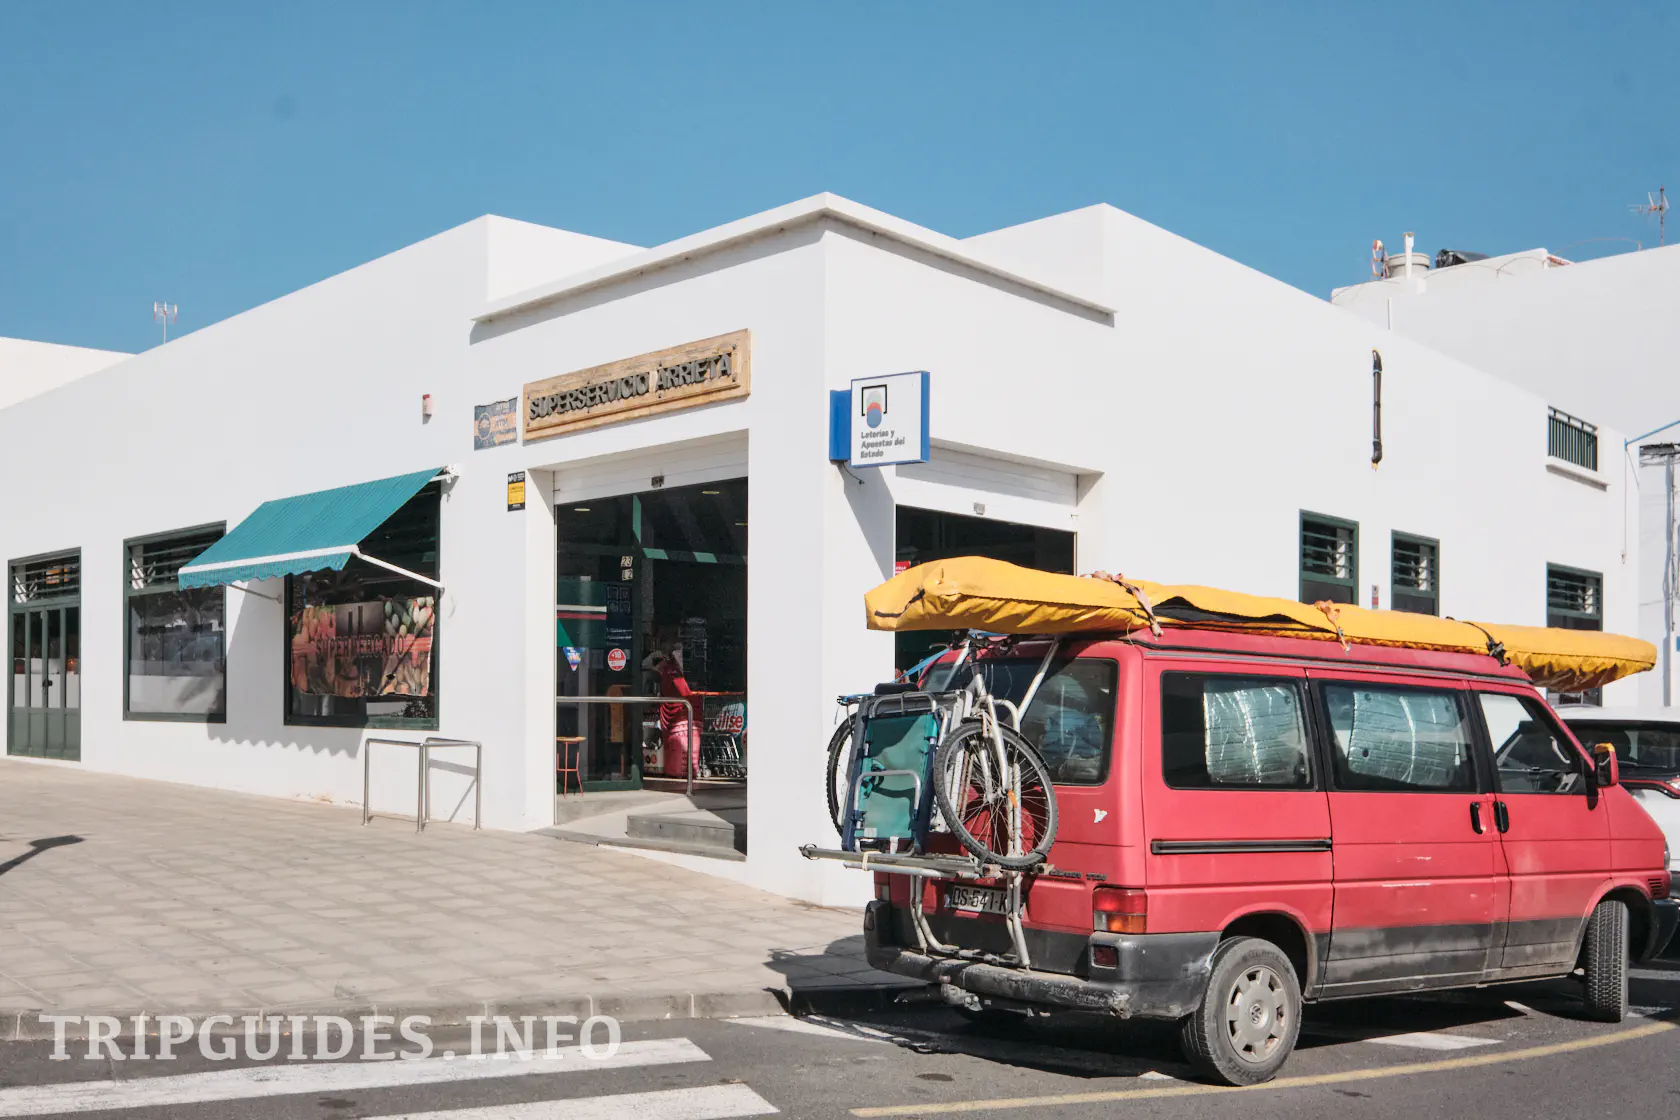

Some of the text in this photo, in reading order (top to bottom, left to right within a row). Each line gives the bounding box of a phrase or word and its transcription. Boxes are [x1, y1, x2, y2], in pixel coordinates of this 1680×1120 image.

[529, 351, 732, 420] SUPERSERVICIO ARRIETA
[861, 436, 905, 450] Apuestas del
[860, 449, 884, 459] Estado
[315, 632, 405, 659] SUPERMERCADO
